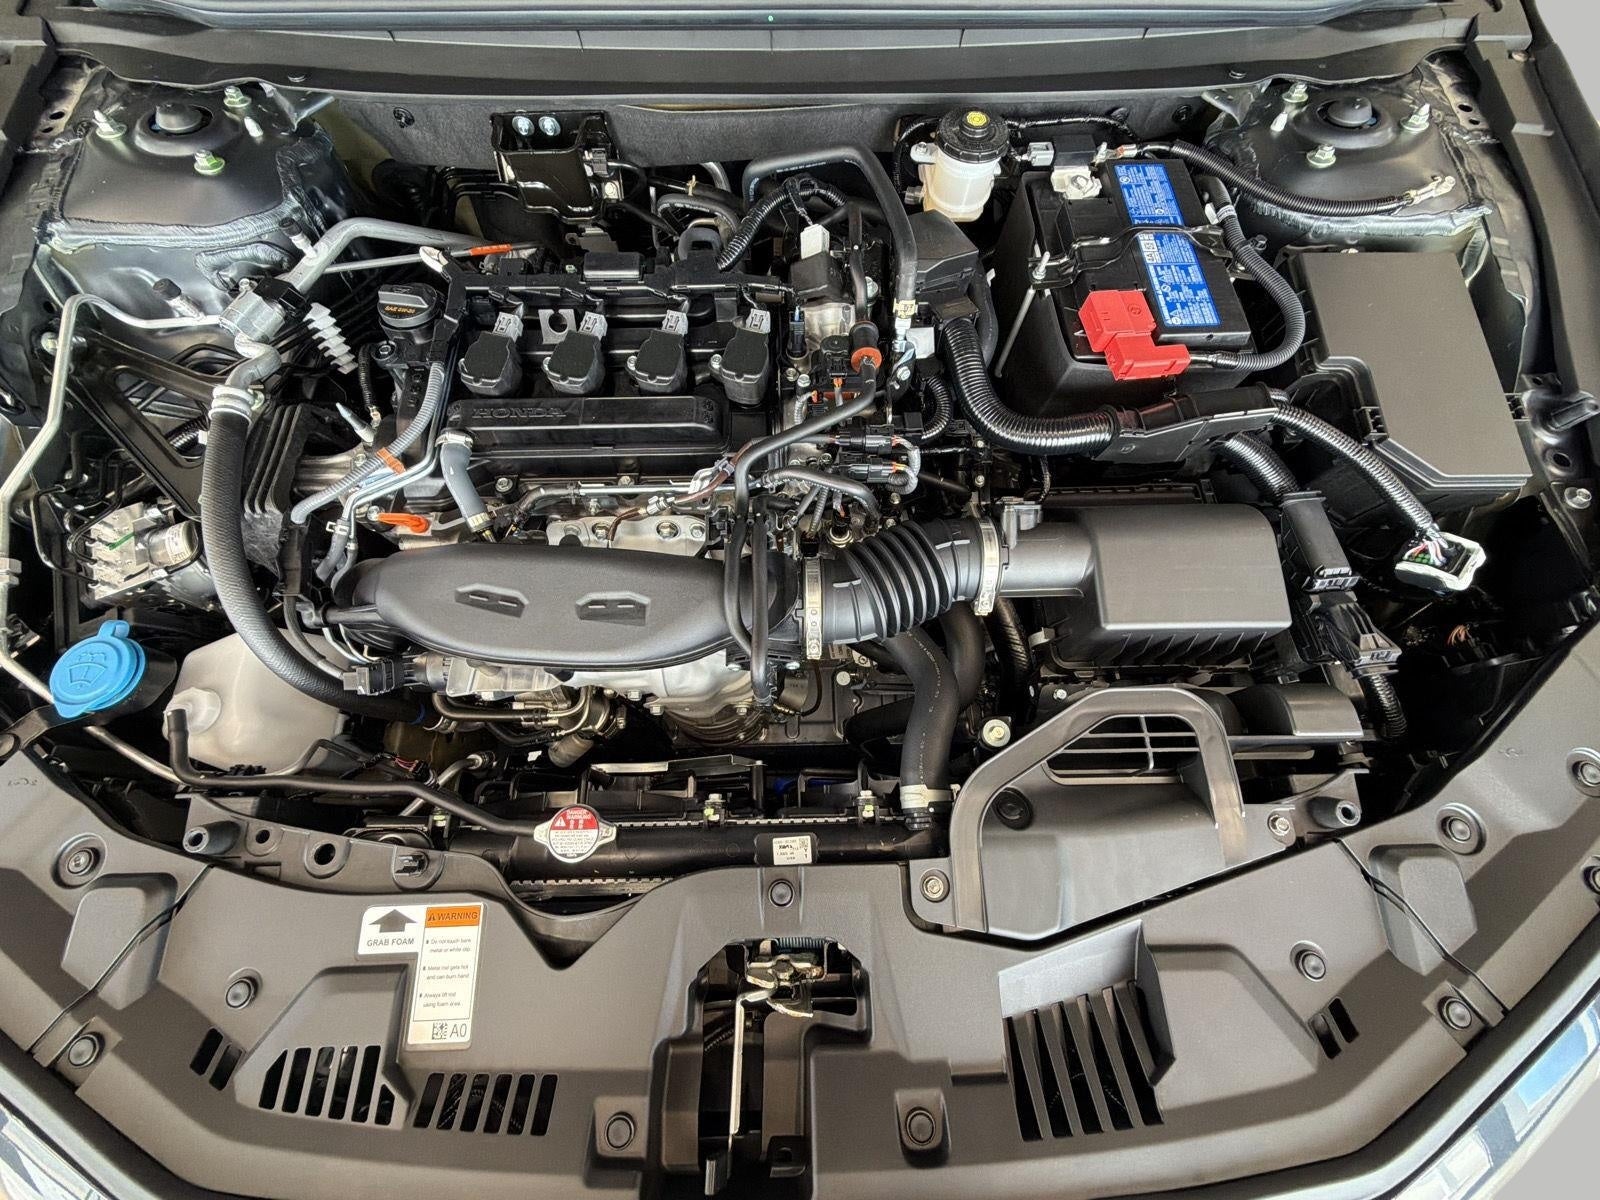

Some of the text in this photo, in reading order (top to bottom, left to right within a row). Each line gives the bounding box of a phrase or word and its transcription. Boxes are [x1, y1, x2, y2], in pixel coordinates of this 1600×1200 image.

[471, 408, 567, 419] HONDA
[437, 911, 479, 921] WARNING
[366, 938, 415, 947] GRAB FOAM
[449, 1023, 468, 1038] A0
